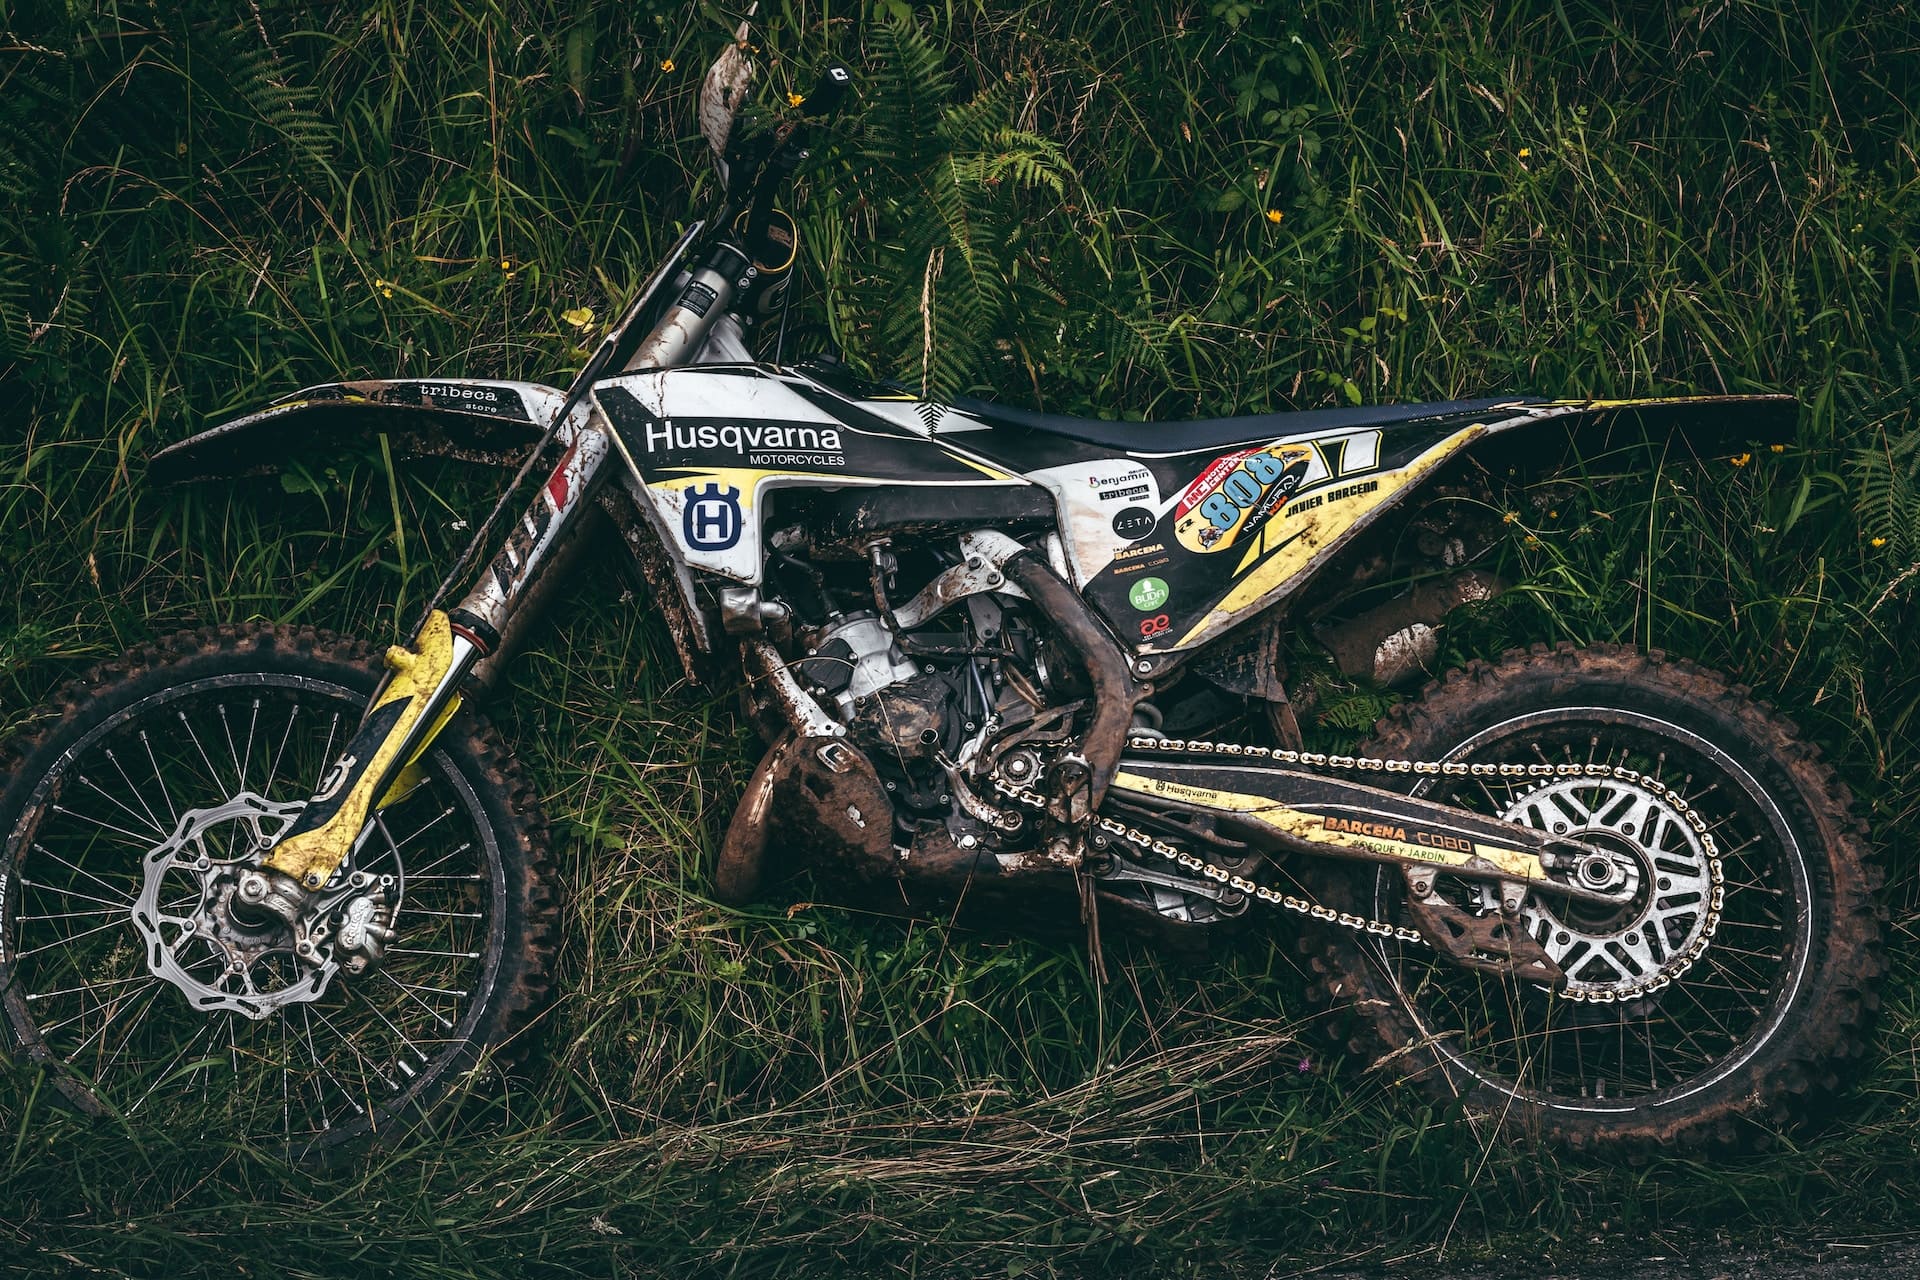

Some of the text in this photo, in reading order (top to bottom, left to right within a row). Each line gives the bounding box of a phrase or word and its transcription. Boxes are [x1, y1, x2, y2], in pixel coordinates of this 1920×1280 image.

[420, 384, 498, 402] tribeca
[465, 403, 497, 413] store
[645, 420, 842, 454] Husqvarna
[750, 454, 845, 466] MOTORCYCLES
[1089, 472, 1149, 488] Benjamin
[1102, 485, 1147, 500] tribeca
[1200, 453, 1284, 533] 808
[1285, 480, 1378, 518] JAVIER BARCENA
[1243, 480, 1295, 532] NAMURA
[1115, 543, 1165, 561] BARCENA
[1135, 589, 1166, 605] BUDA
[1166, 784, 1218, 799] Husqvarna
[1325, 816, 1472, 852] BARCENA COBO
